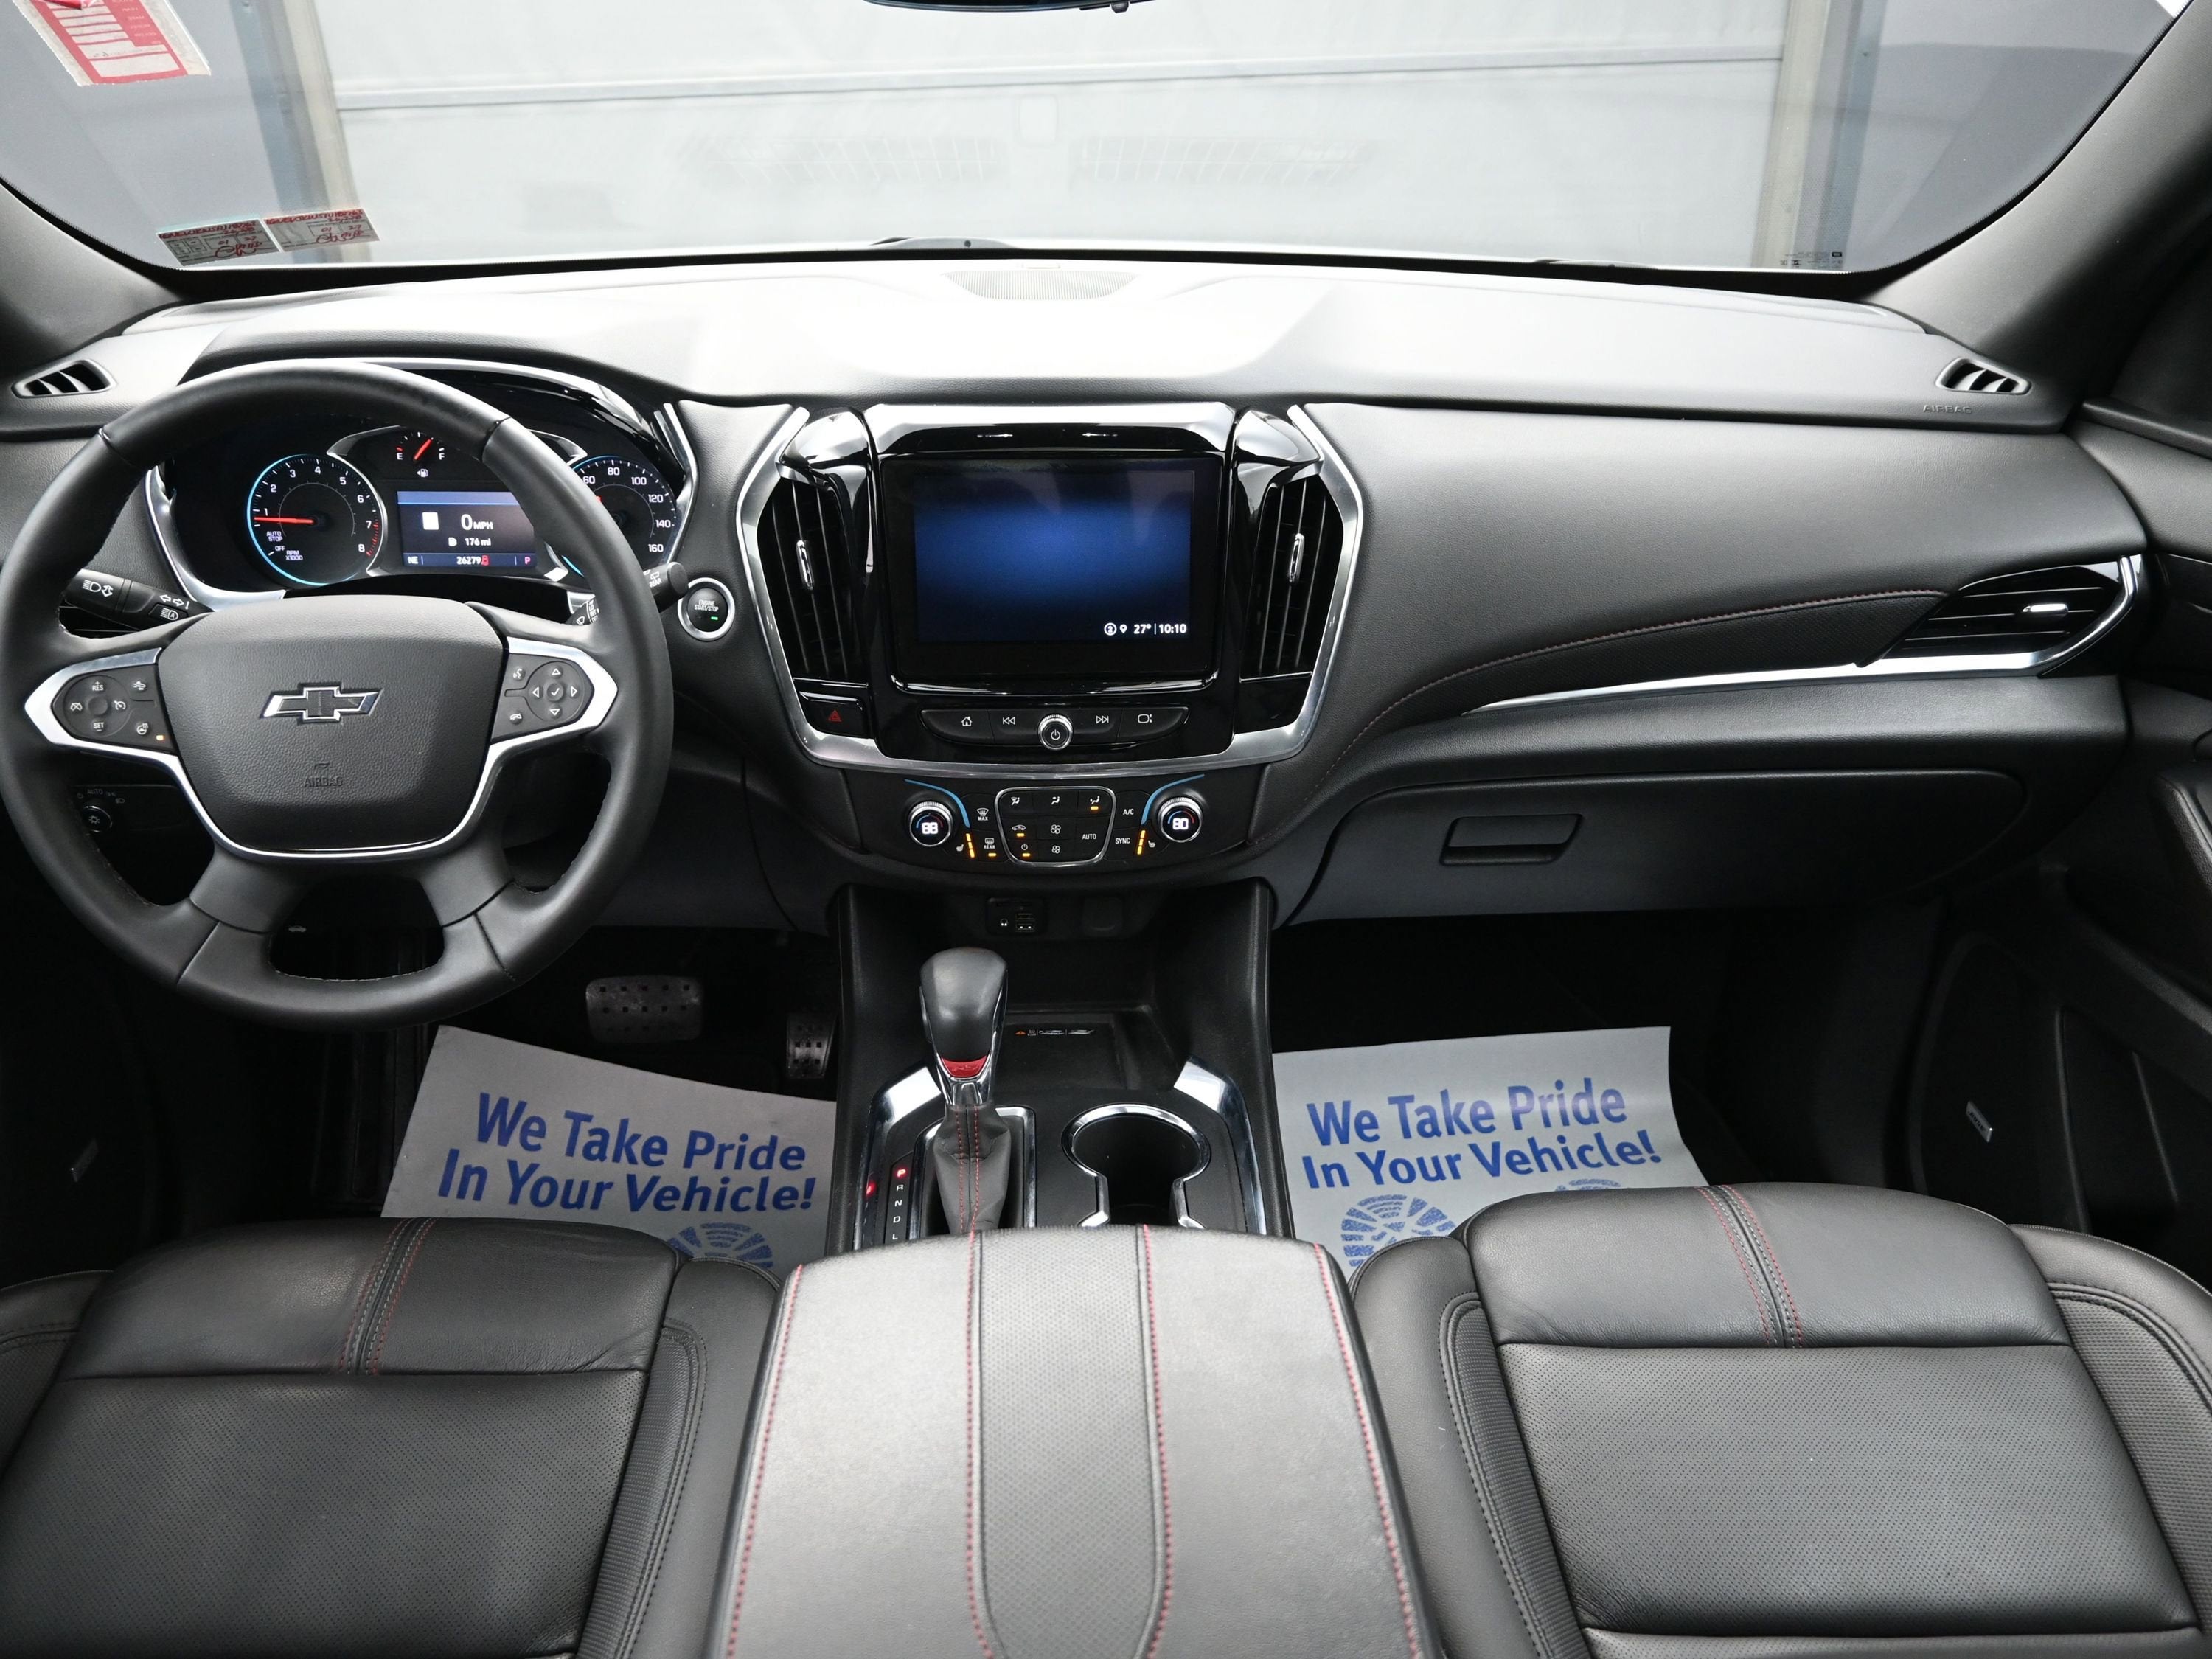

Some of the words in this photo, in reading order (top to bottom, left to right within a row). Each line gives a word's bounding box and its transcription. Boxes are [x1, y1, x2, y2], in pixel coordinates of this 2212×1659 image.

[1923, 405, 1972, 414] AIRBAG
[290, 470, 296, 478] 3
[608, 467, 620, 476] 80
[339, 477, 346, 485] 5
[582, 476, 595, 484] 60
[631, 477, 647, 485] 100
[270, 484, 276, 493] 2
[357, 495, 364, 503] 6
[648, 495, 664, 503] 120
[264, 508, 268, 516] 1
[366, 521, 372, 529] 7
[461, 514, 473, 530] 0
[473, 521, 493, 529] MPH
[655, 520, 671, 528] 140
[465, 538, 479, 546] 176
[481, 538, 491, 546] mi
[358, 544, 365, 552] 8
[648, 544, 664, 552] 160
[456, 556, 481, 565] 26279
[649, 577, 662, 588] REAR
[1133, 624, 1152, 634] 27°
[1158, 623, 1187, 633] 10:10
[1307, 1099, 1380, 1147] We
[1388, 1088, 1496, 1140] Take
[1507, 1077, 1628, 1131] Pride
[477, 1092, 547, 1152] We
[563, 1110, 668, 1167] Take
[683, 1130, 806, 1171] Pride
[1302, 1155, 1350, 1189] In
[1357, 1150, 1463, 1186] Your
[1468, 1130, 1662, 1178] Vehicle!
[897, 1169, 906, 1178] P
[437, 1149, 488, 1201] In
[507, 1159, 613, 1210] Your
[627, 1173, 816, 1212] Vehicle!
[894, 1199, 902, 1207] N
